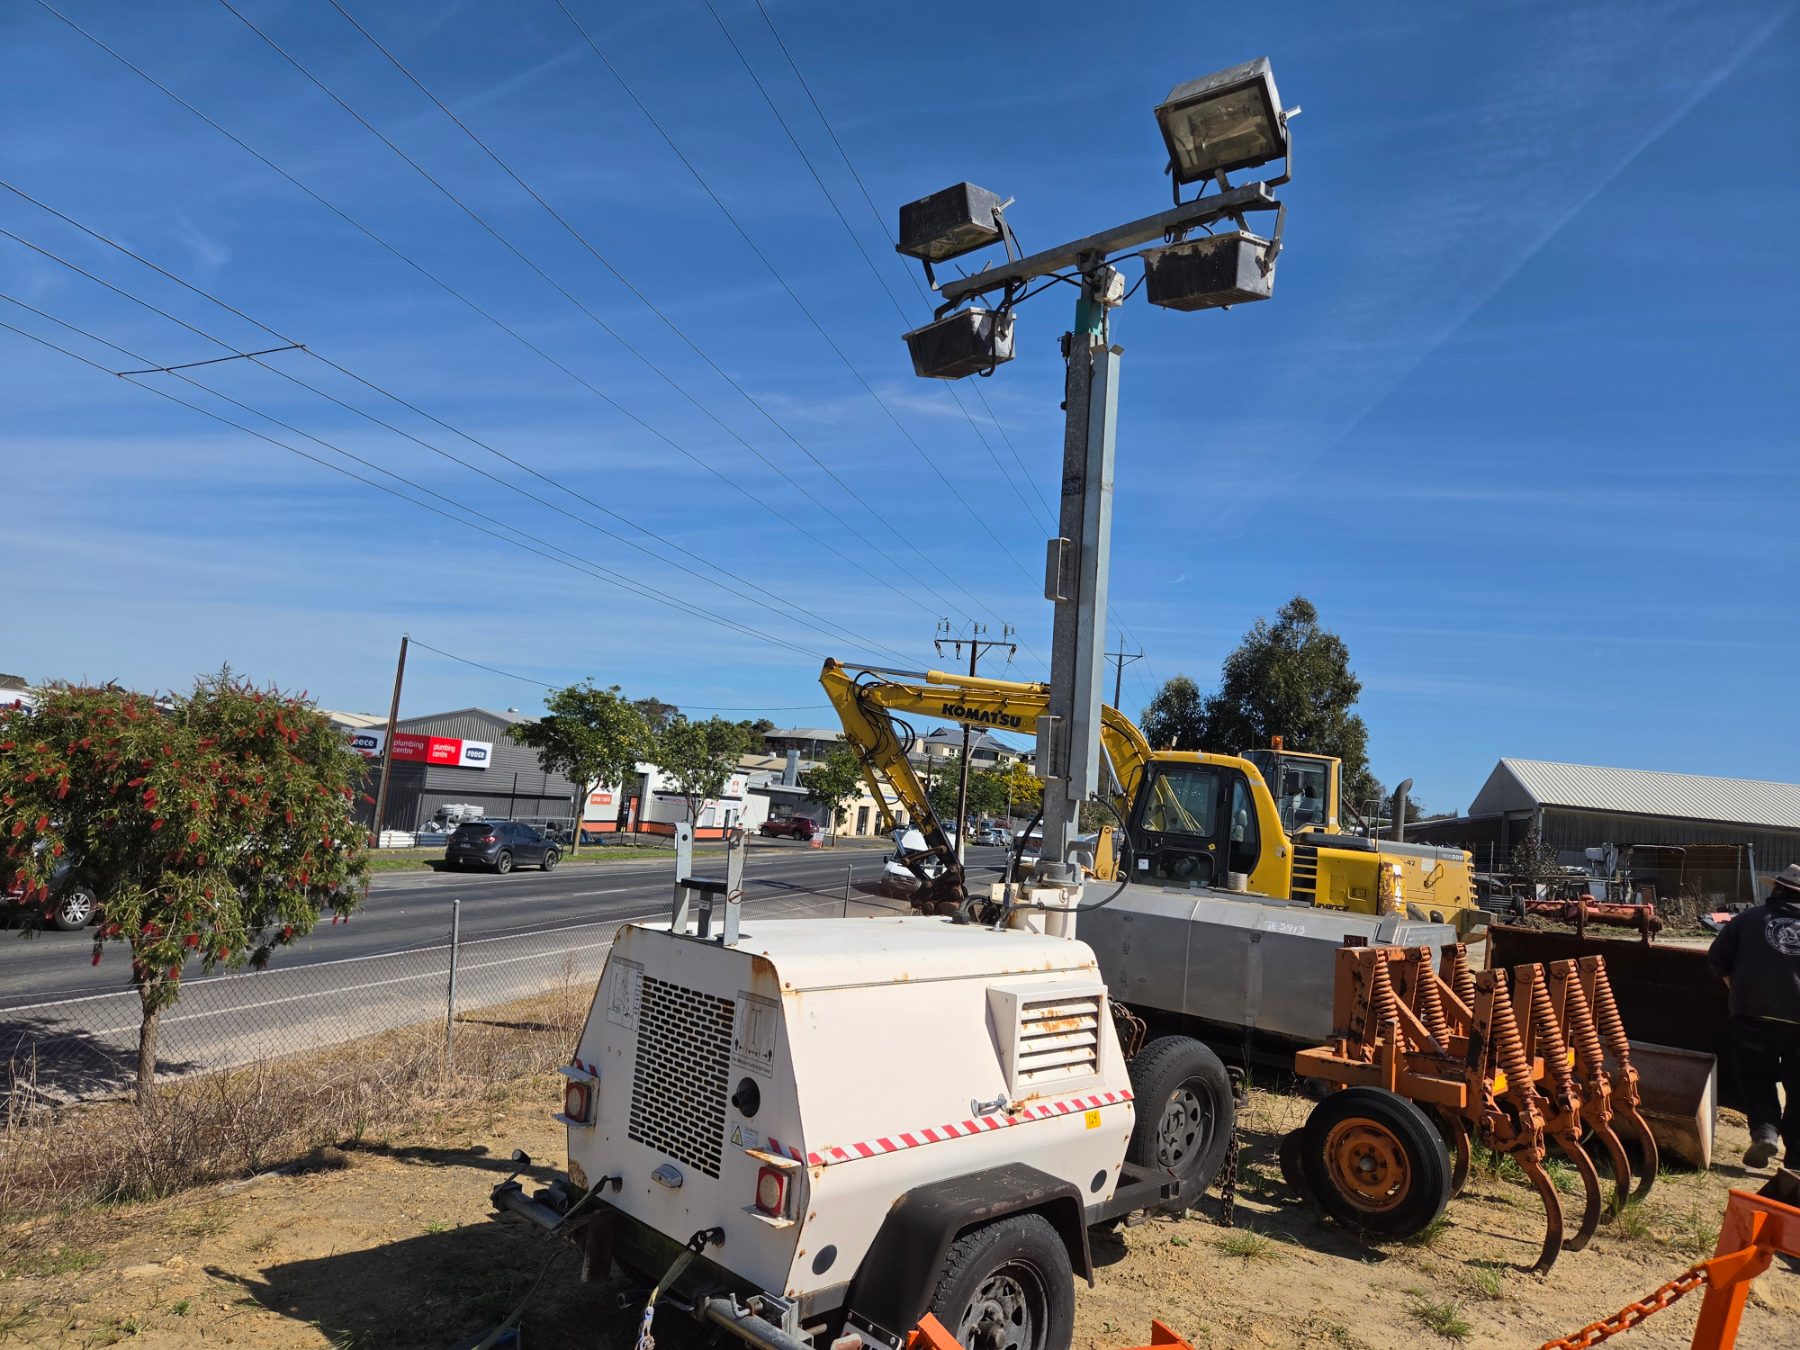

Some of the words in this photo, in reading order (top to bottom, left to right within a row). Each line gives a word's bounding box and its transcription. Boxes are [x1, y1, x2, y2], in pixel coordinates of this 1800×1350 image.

[942, 703, 1021, 727] KOMATSU
[353, 738, 375, 747] eece
[393, 740, 424, 749] plumbing
[392, 747, 413, 755] centre
[433, 743, 456, 752] plumbing
[467, 749, 485, 759] reece
